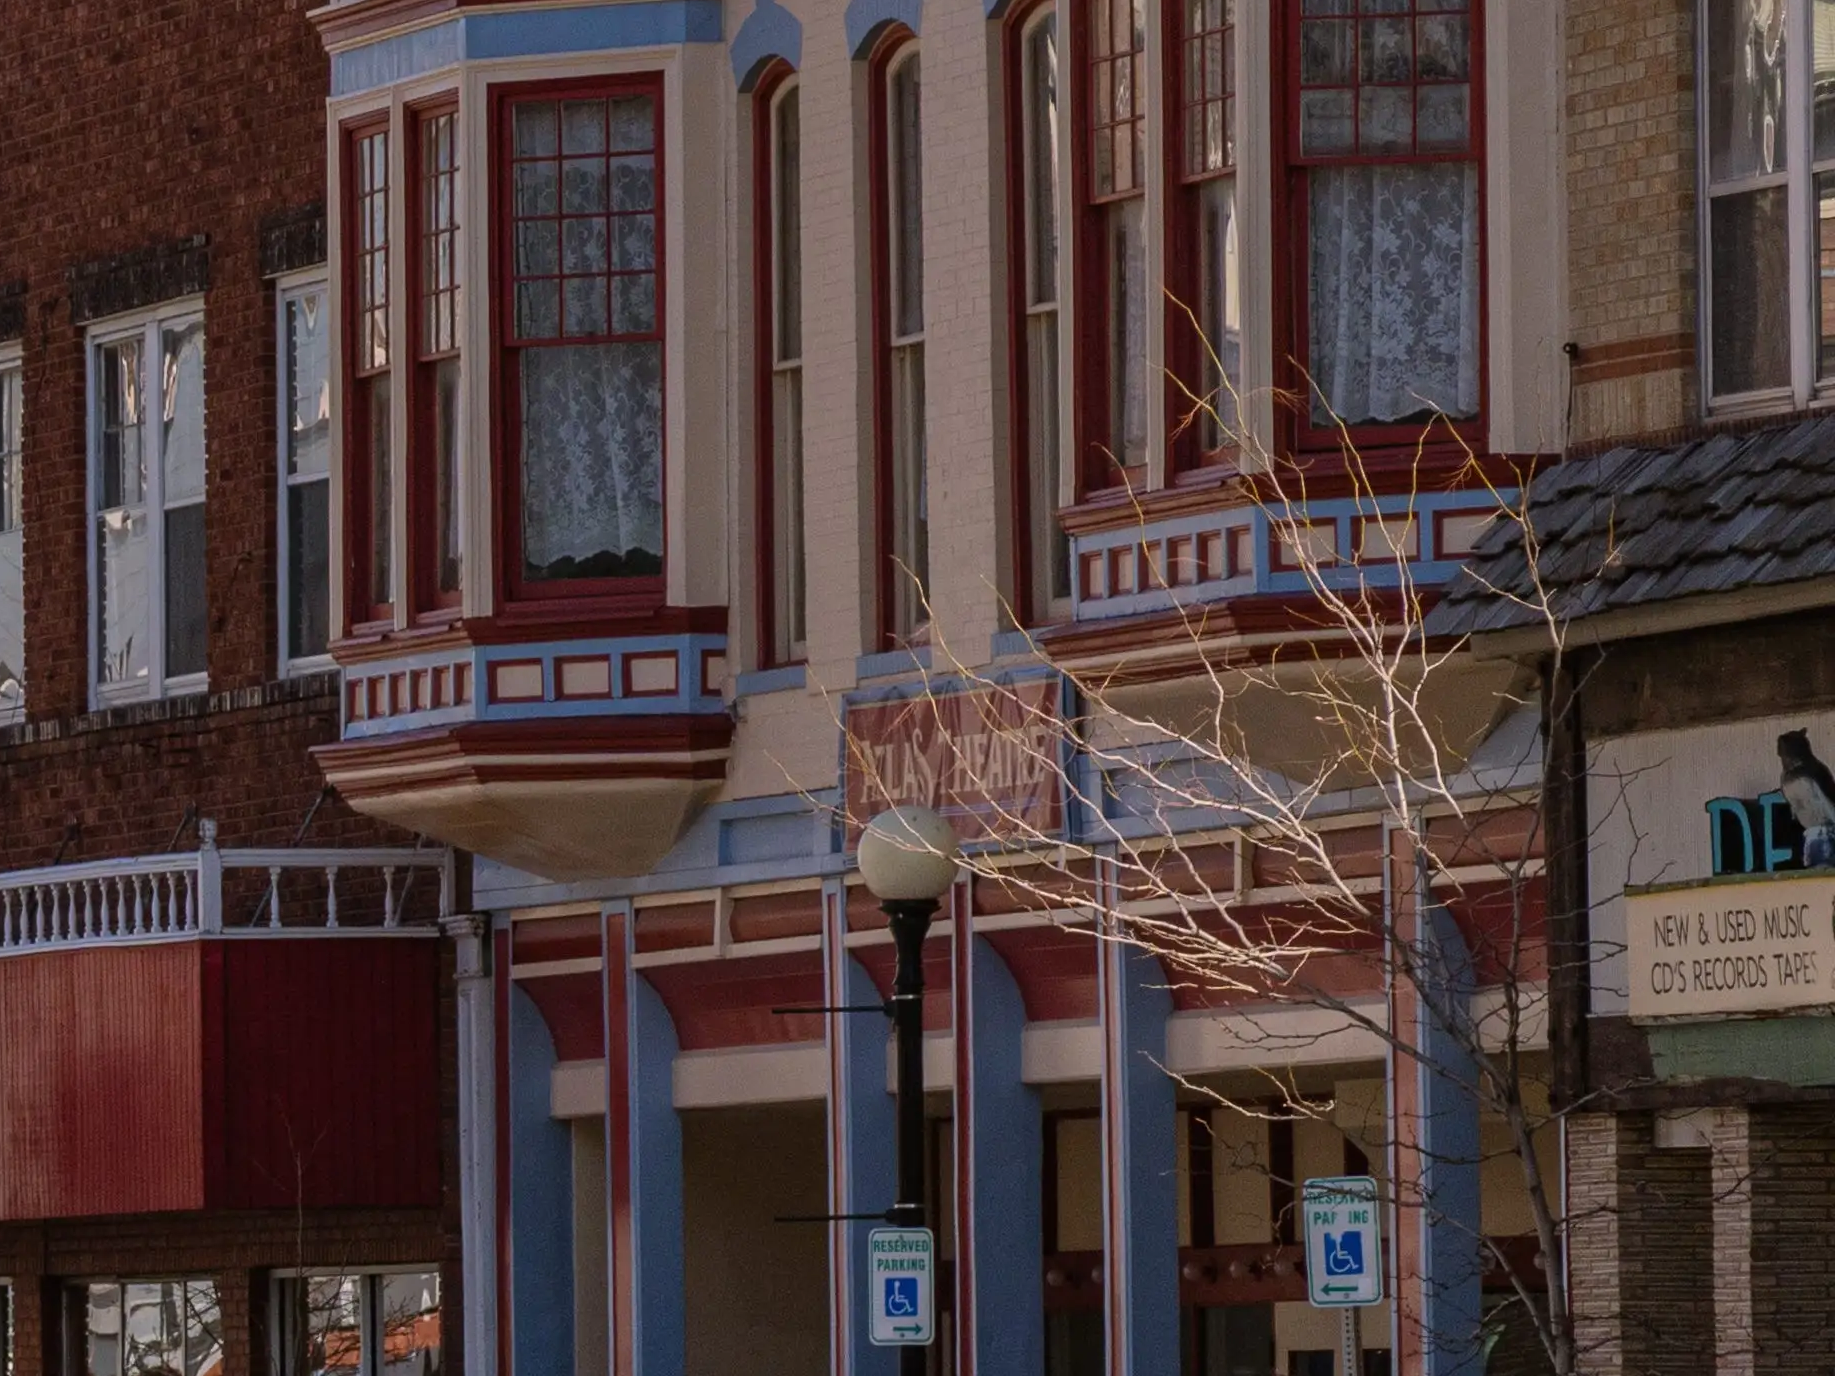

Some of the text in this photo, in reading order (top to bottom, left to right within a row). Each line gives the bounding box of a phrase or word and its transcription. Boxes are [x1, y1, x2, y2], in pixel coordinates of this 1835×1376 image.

[1653, 903, 1811, 949] NEW & USED MUSIC
[1650, 950, 1818, 995] CD'S RECORDS TAPES
[873, 1240, 930, 1253] RESERVED
[876, 1258, 927, 1272] PARKING
